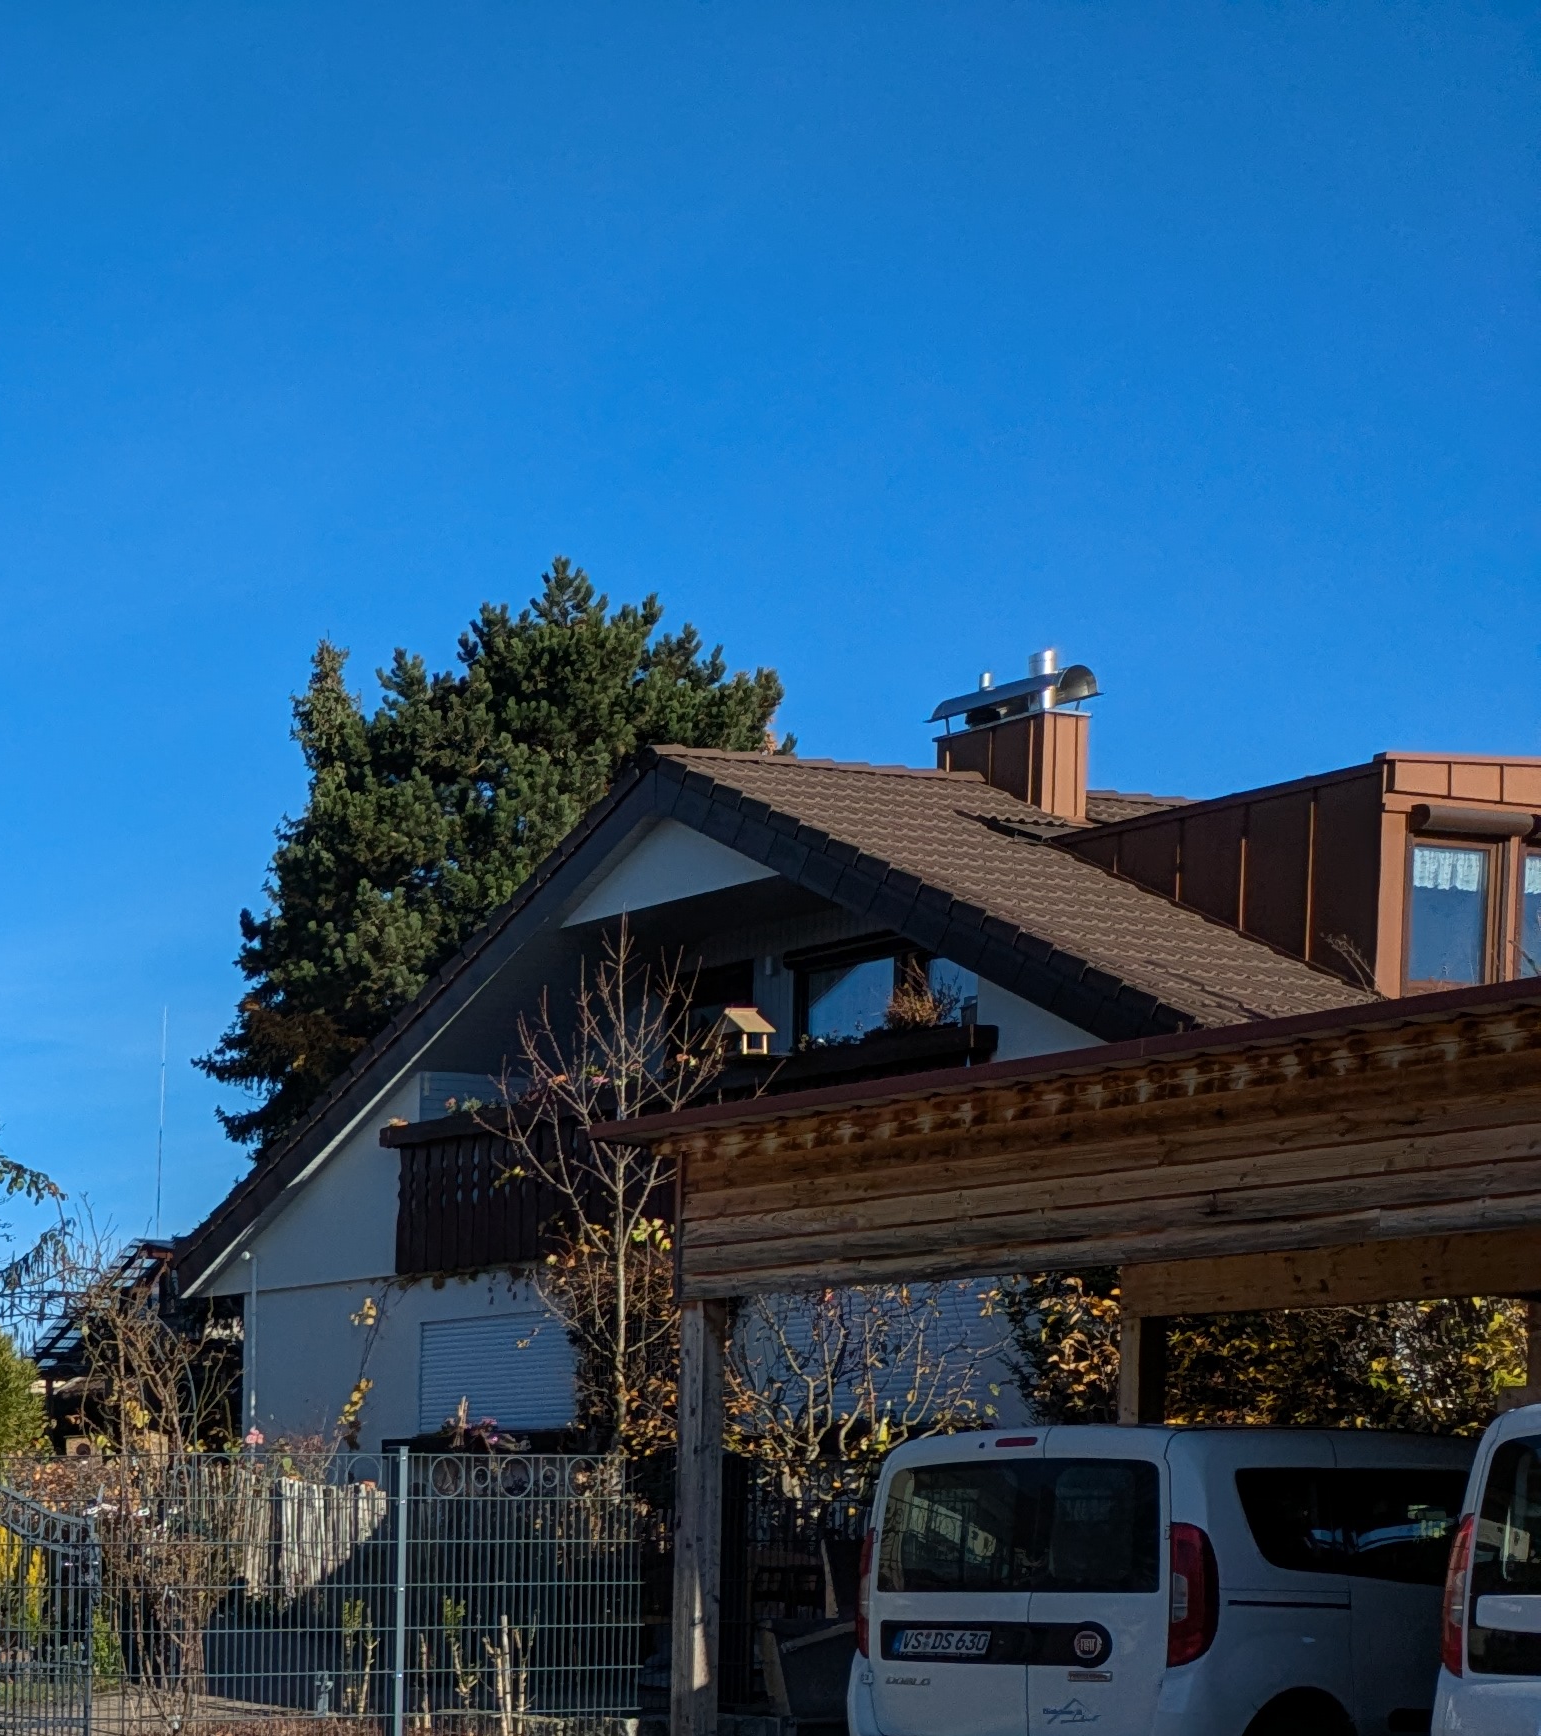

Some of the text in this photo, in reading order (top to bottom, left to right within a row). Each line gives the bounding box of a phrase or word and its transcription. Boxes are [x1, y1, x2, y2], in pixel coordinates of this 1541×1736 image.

[903, 1631, 989, 1651] VS DS 630
